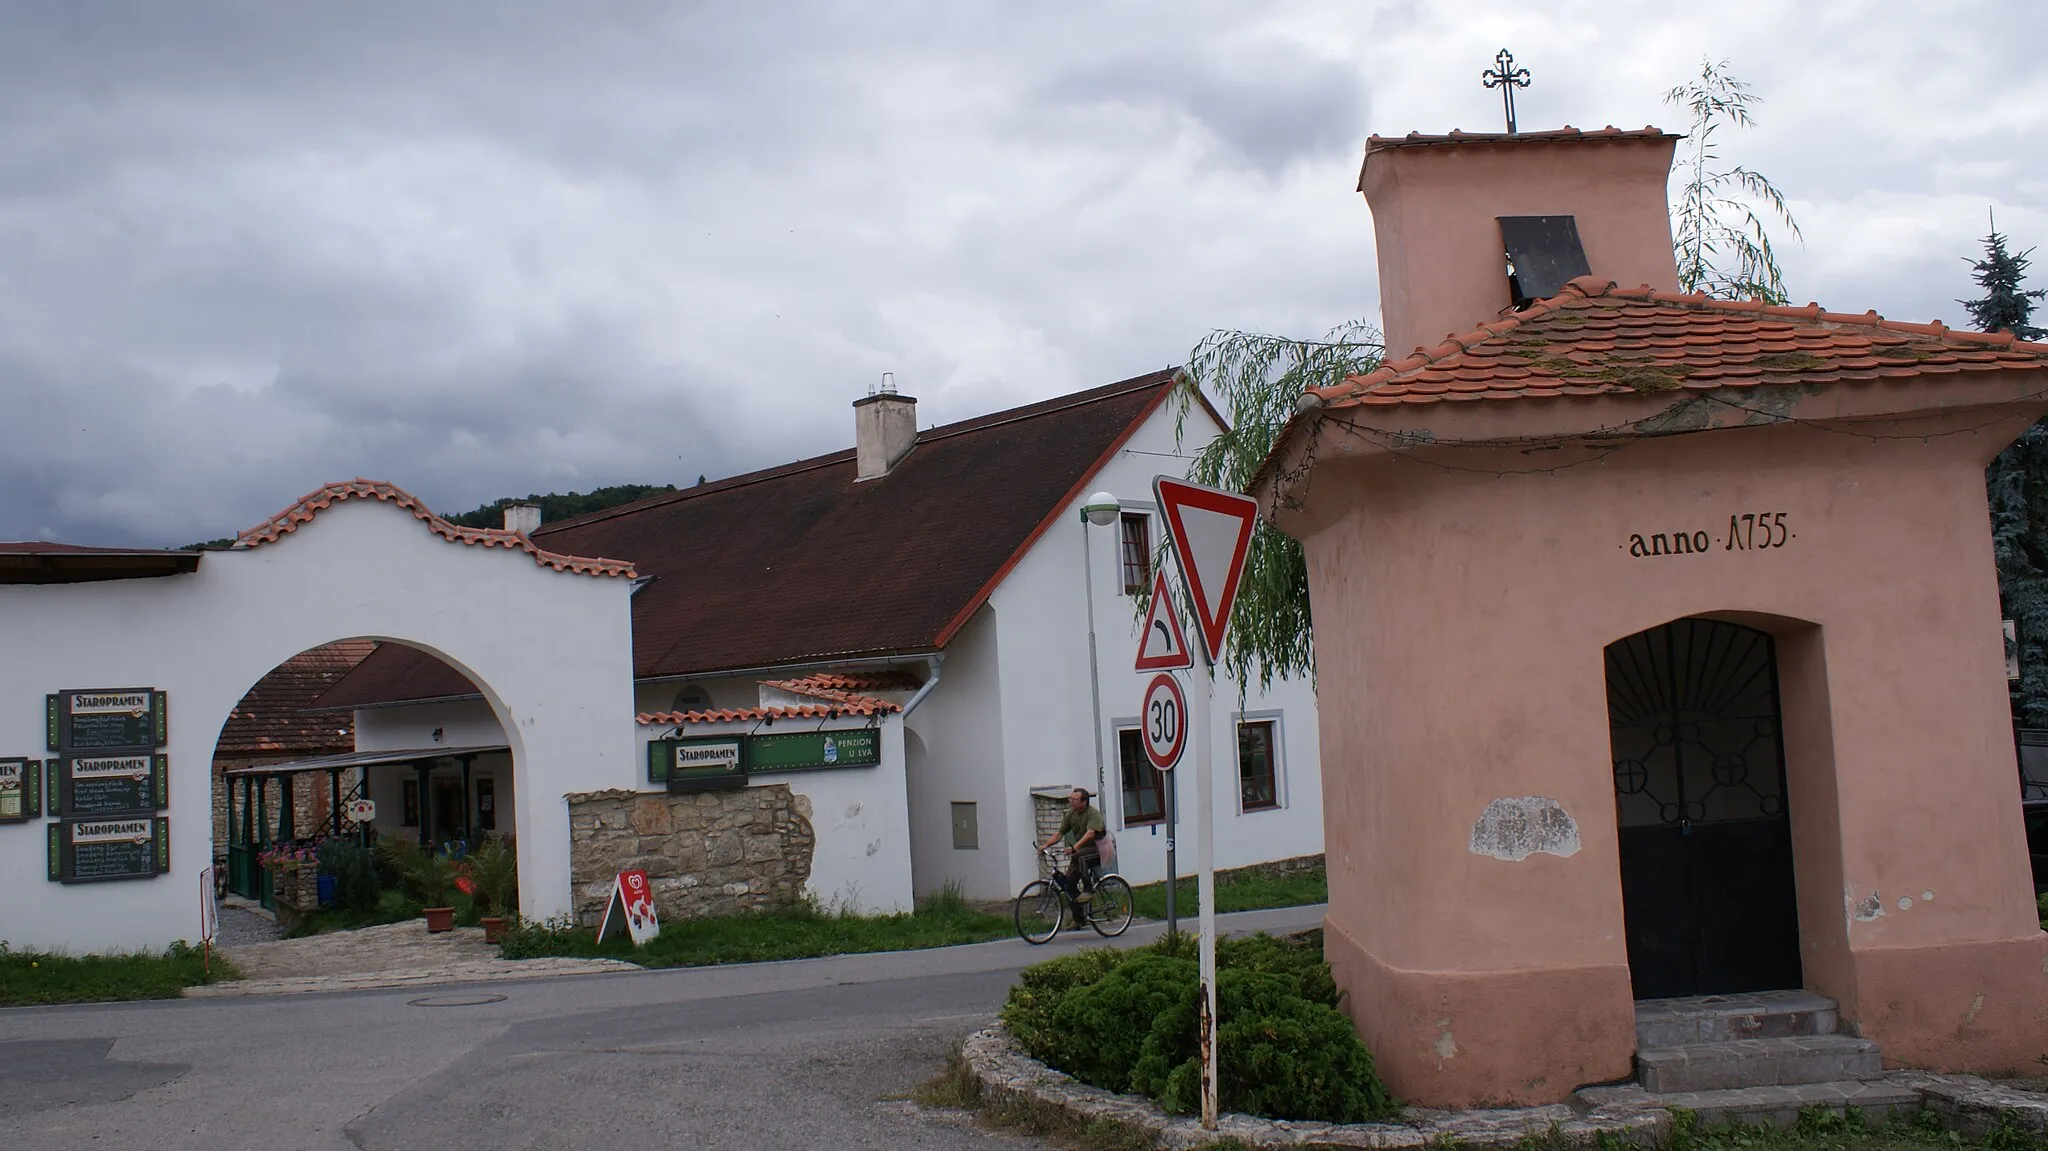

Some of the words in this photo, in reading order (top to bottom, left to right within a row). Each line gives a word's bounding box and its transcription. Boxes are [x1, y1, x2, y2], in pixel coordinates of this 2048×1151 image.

[76, 695, 144, 708] STAROPRAMEN
[1151, 699, 1175, 743] 30
[838, 738, 872, 748] PENZION
[680, 748, 736, 761] STAROPRAMEN
[858, 748, 873, 757] LVA
[77, 759, 145, 772] STAROPRAMEN
[77, 823, 147, 836] STAROPRAMEN
